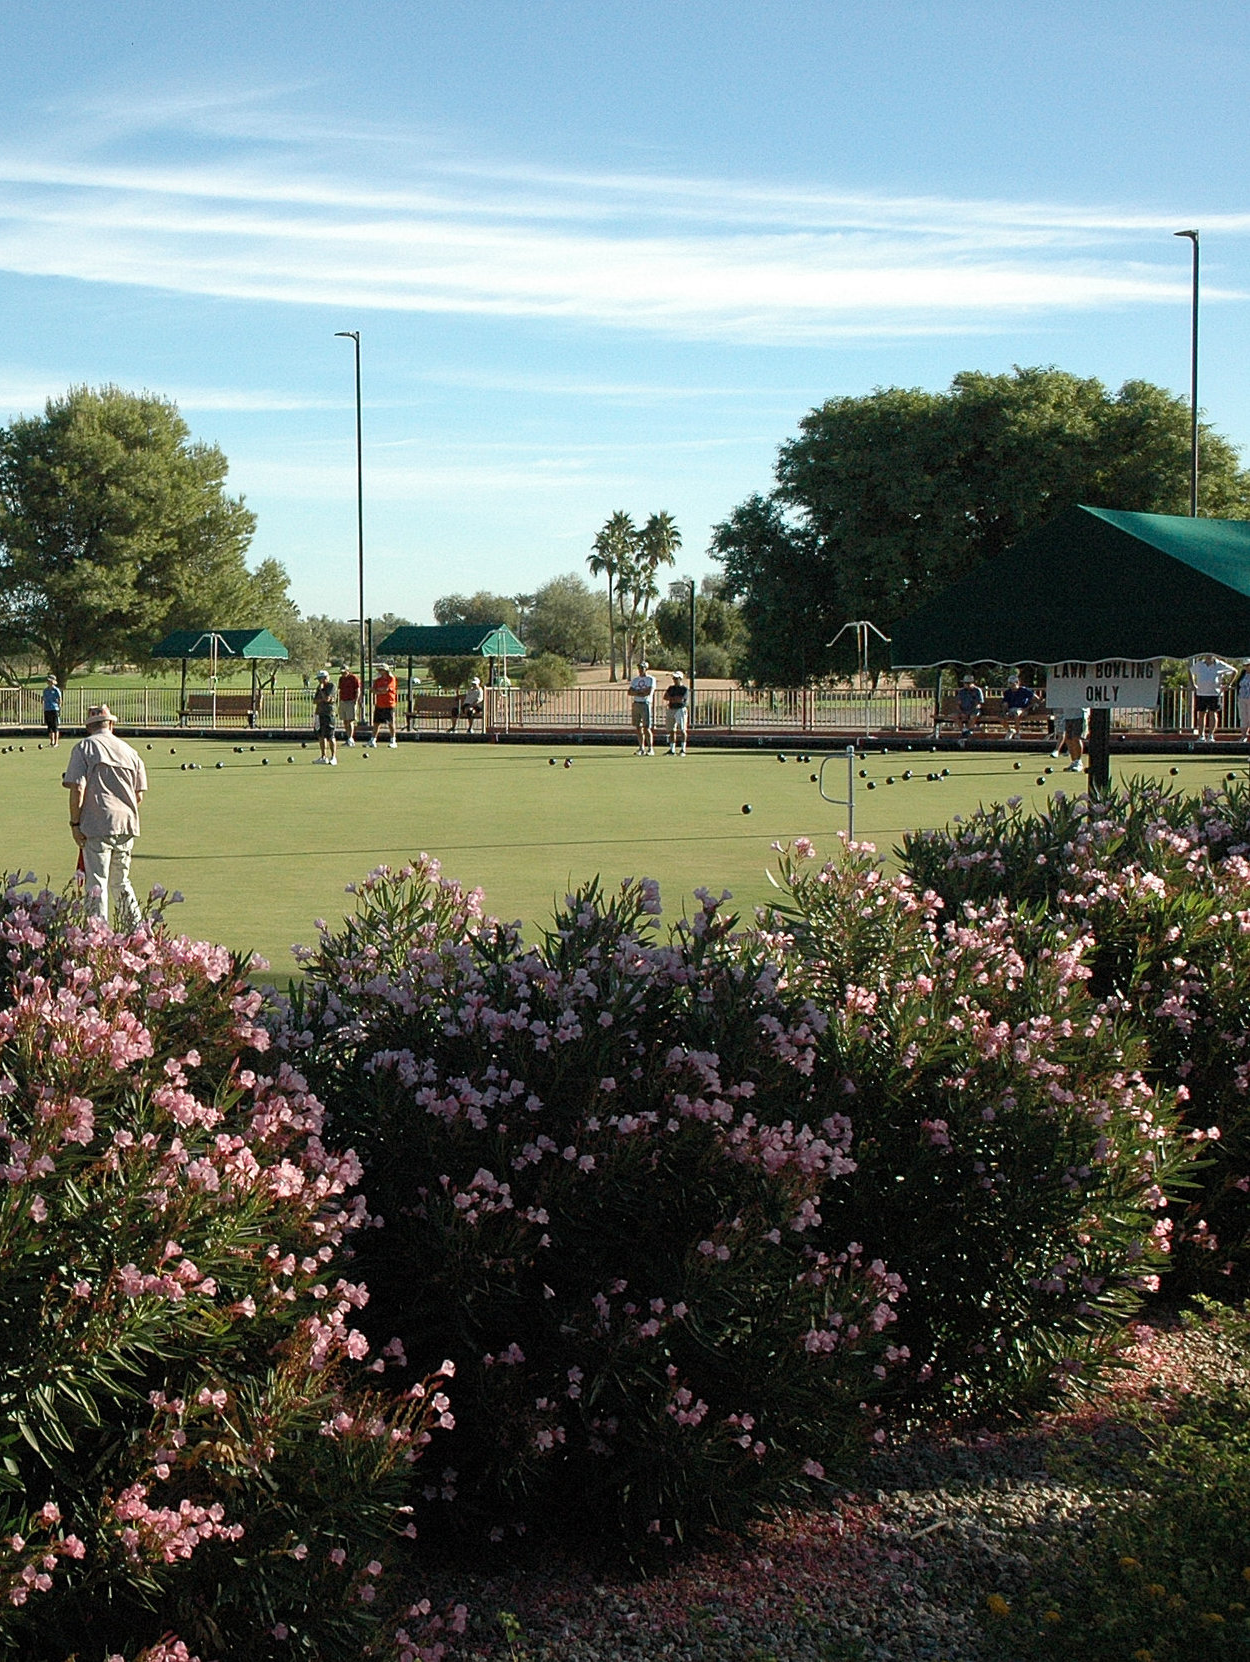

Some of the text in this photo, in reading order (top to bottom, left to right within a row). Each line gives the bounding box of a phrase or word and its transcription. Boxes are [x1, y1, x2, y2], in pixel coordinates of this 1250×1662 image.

[1053, 662, 1153, 678] LAWN BOWLING
[1086, 686, 1119, 701] ONLY
